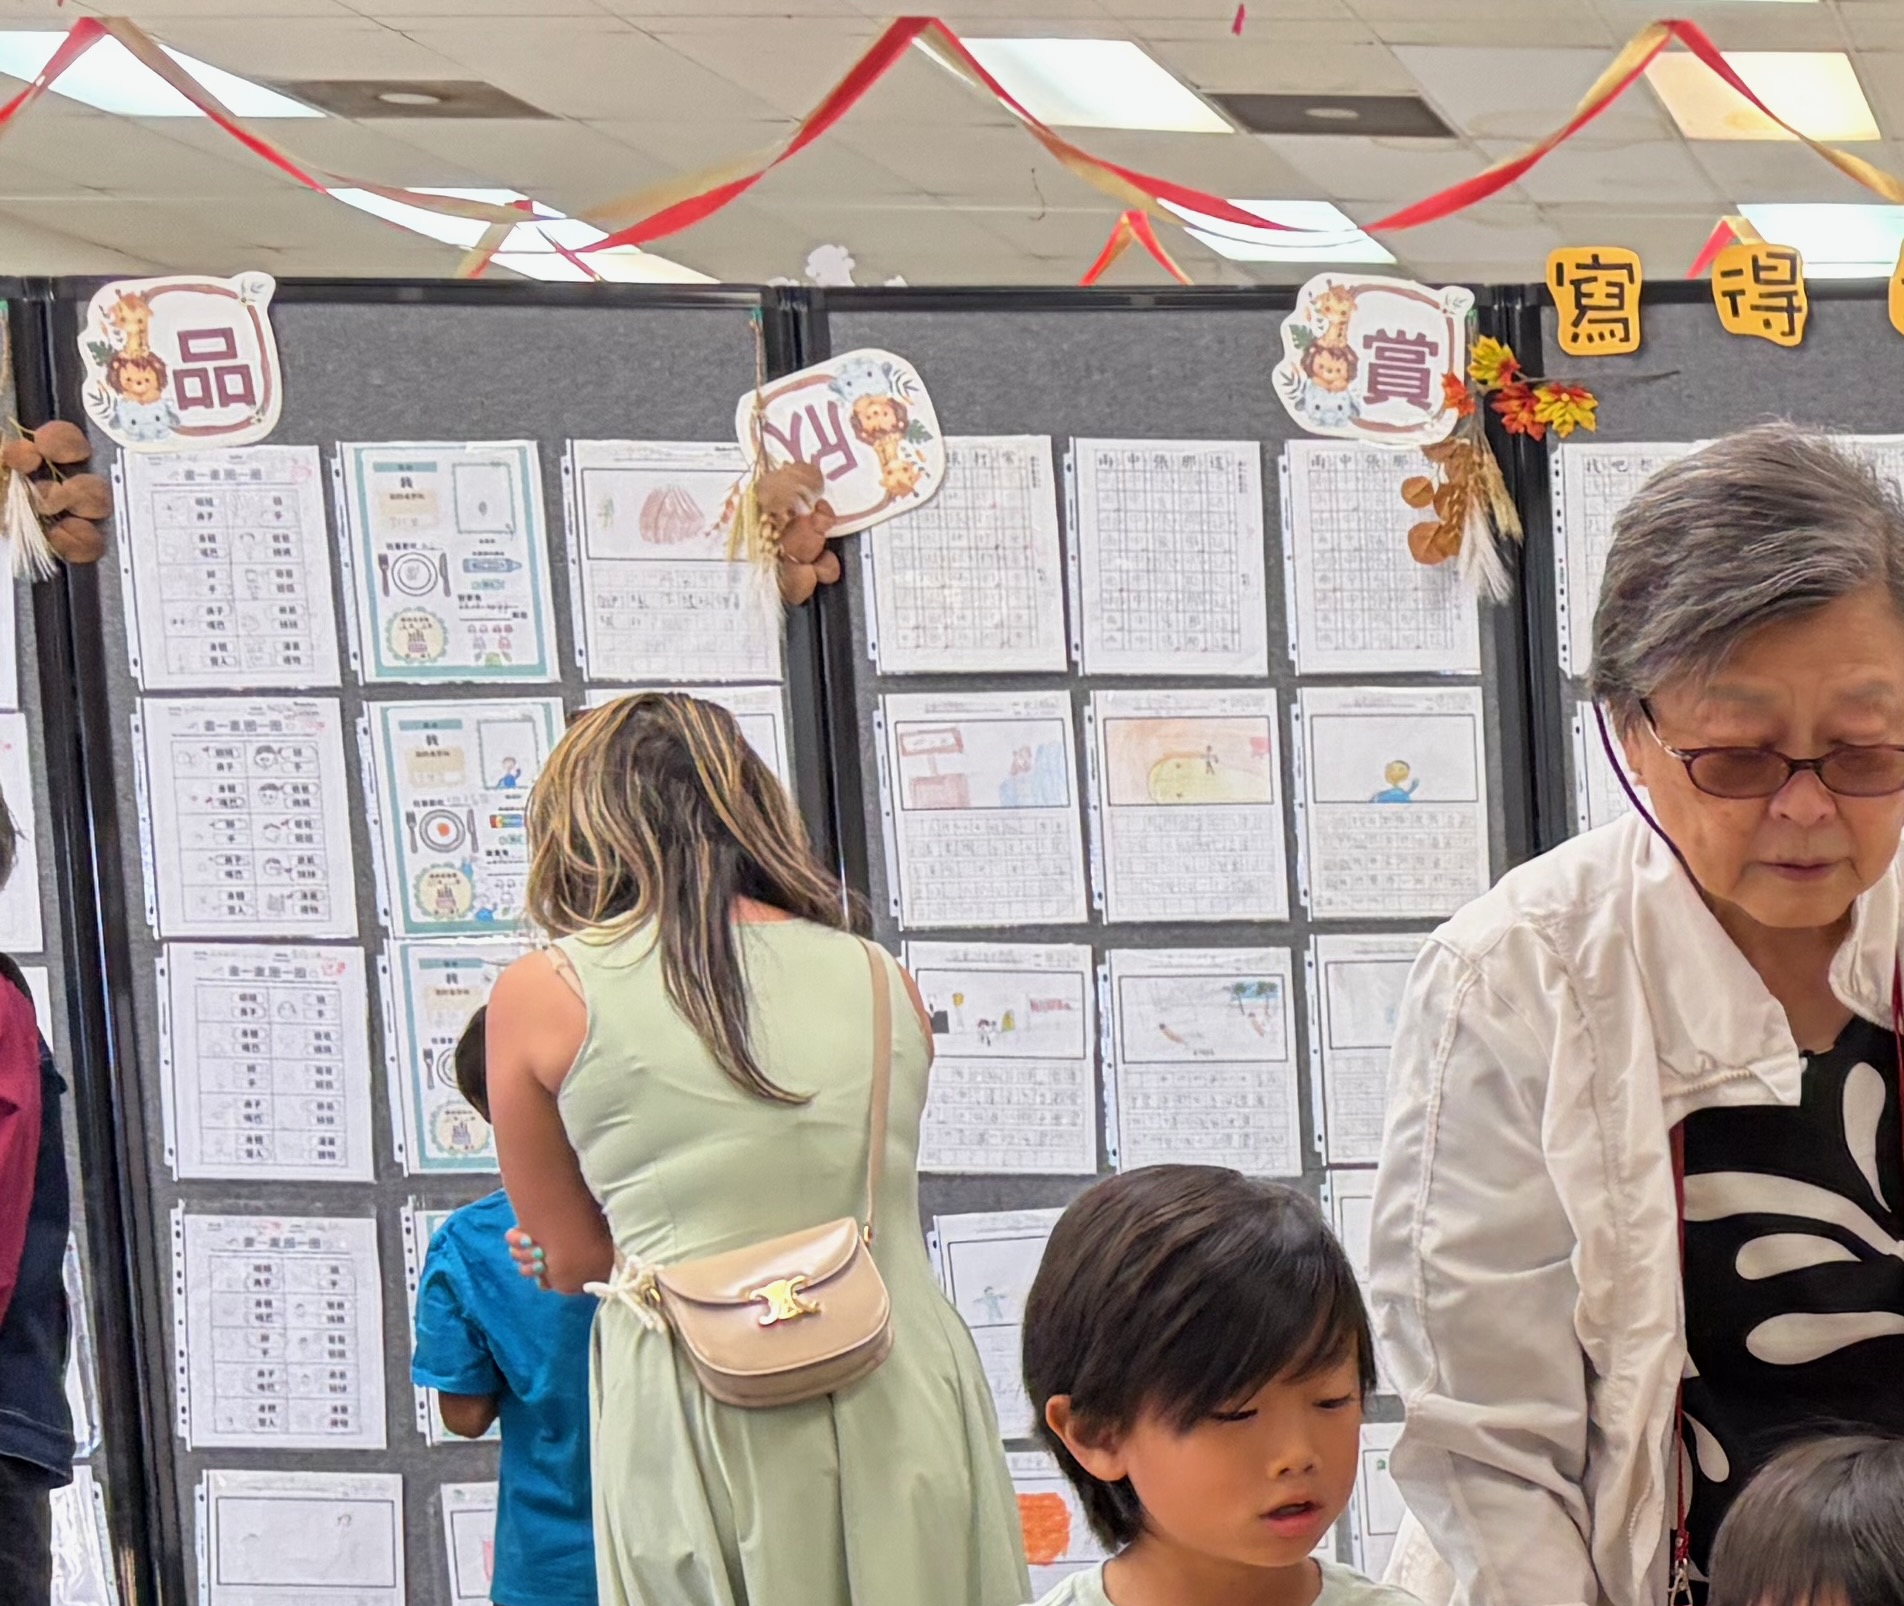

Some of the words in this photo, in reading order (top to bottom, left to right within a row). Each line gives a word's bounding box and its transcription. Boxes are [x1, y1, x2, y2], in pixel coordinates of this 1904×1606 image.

[1555, 254, 1637, 345] 寫
[1719, 252, 1805, 338] 得
[172, 327, 257, 411] 品
[1362, 328, 1439, 412] 賞
